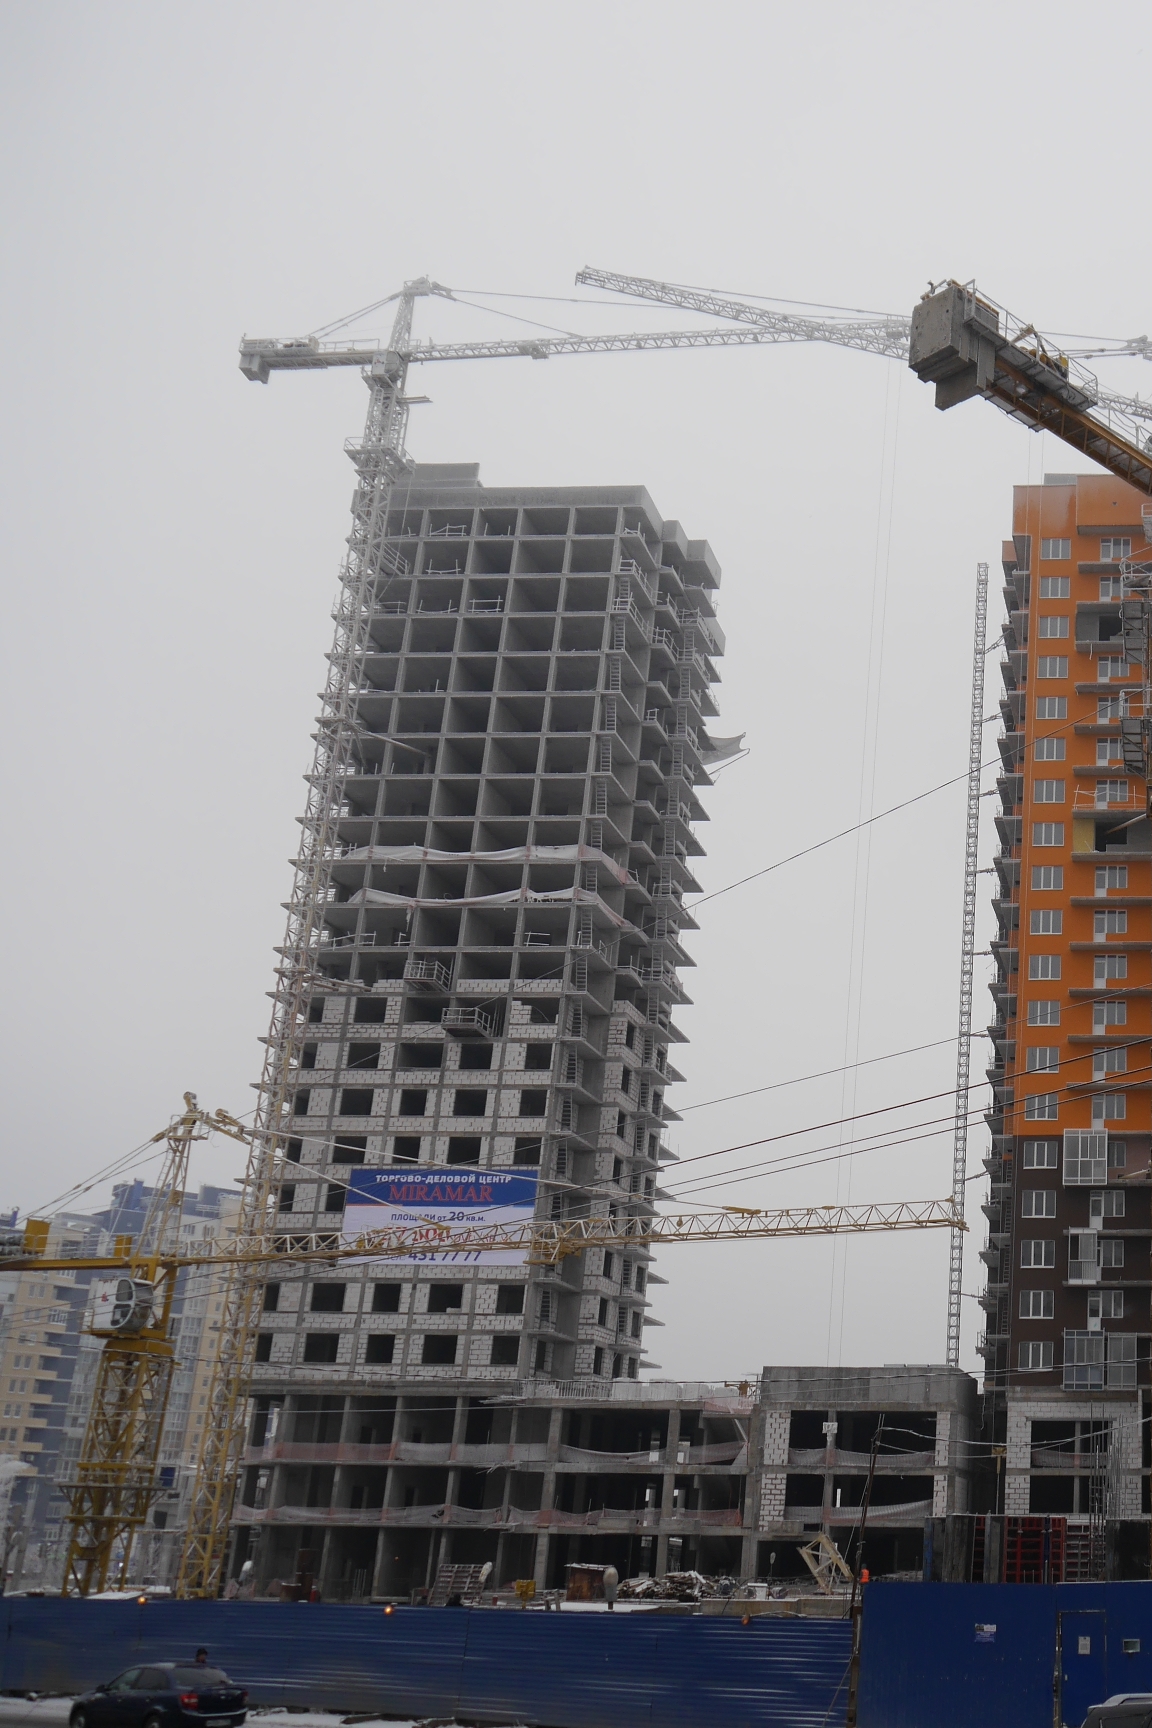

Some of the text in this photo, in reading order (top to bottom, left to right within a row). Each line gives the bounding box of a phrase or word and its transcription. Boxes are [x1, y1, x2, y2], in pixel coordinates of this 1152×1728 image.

[376, 1174, 512, 1185] ТОРГОВО-ДЕЛОВОЙ ЦЕНТР
[388, 1184, 493, 1202] MIRAMAR
[391, 1213, 436, 1222] ПЛОЩДИ
[449, 1211, 465, 1222] 20
